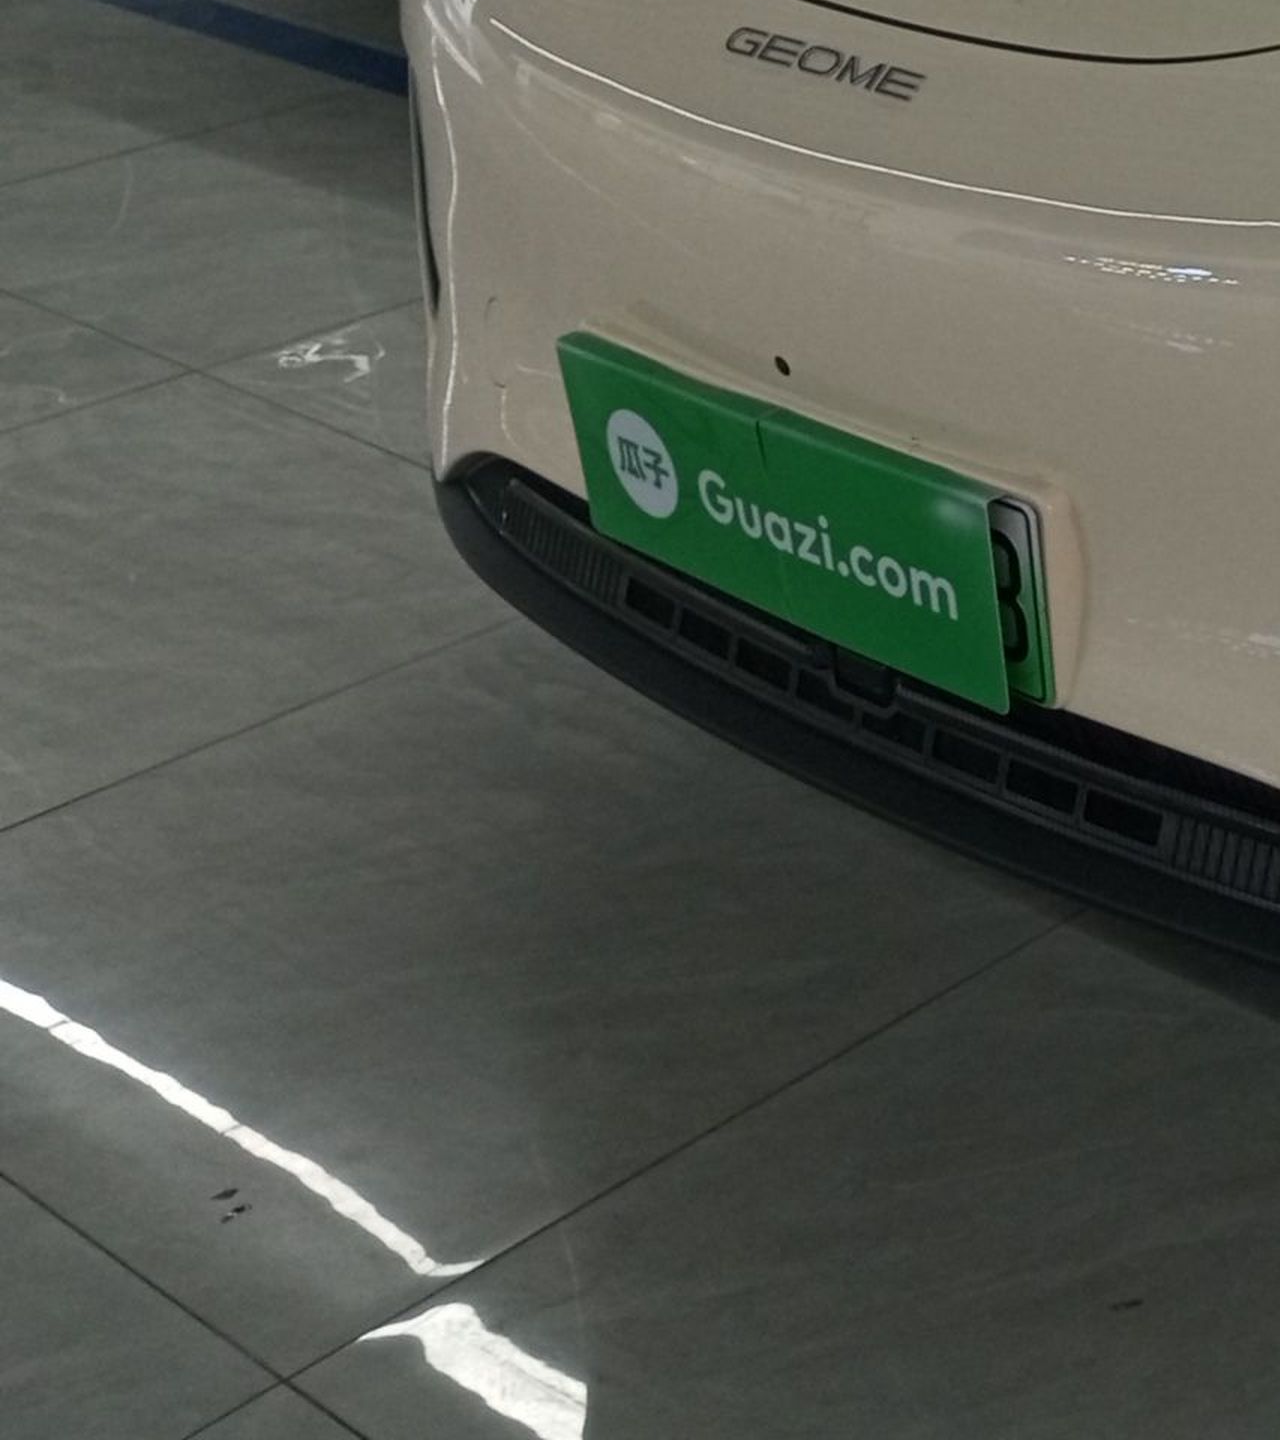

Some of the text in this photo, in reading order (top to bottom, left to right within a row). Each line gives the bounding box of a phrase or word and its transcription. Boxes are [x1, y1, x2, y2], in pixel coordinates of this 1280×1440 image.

[726, 27, 927, 101] GEOME
[617, 436, 670, 490] 瓜子
[697, 469, 959, 621] Guazi.com
